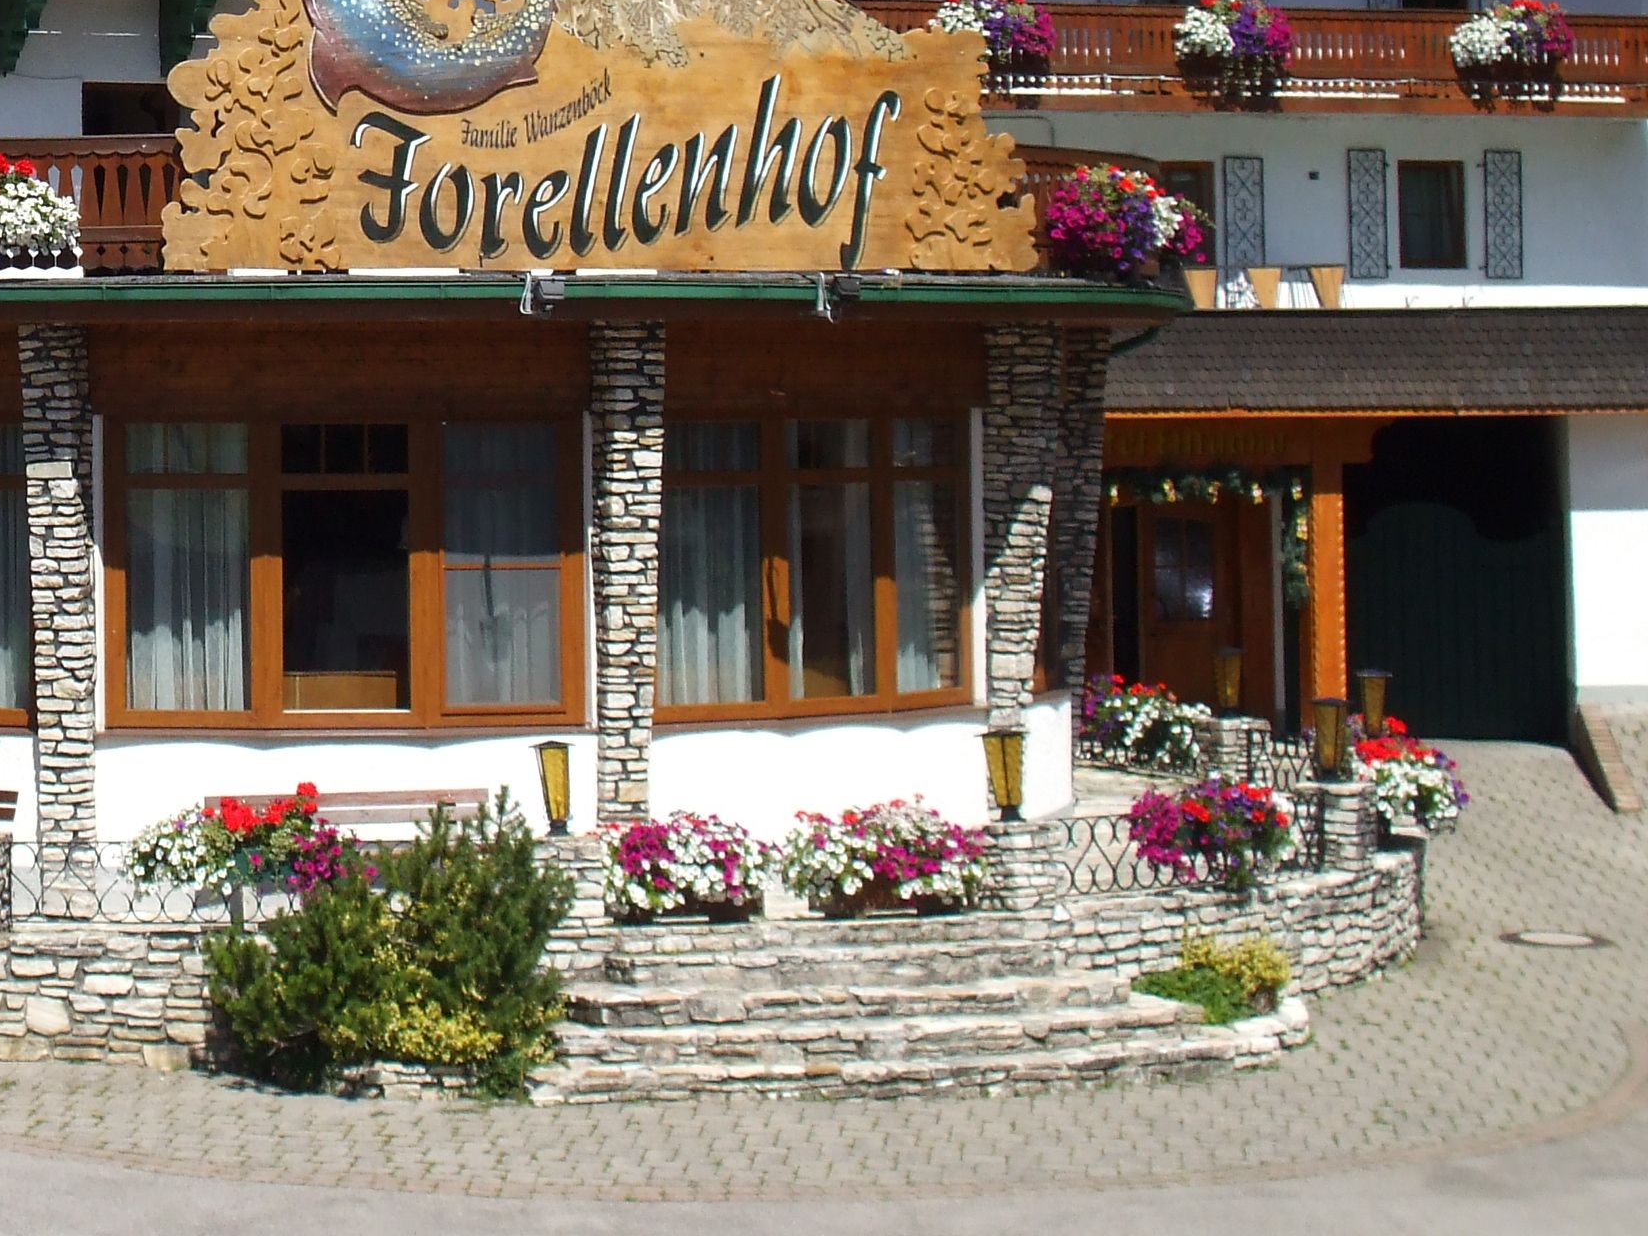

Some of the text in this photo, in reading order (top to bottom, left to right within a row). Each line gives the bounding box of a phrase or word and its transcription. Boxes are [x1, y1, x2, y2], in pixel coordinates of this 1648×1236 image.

[351, 73, 900, 271] Forellenhof
[461, 67, 612, 150] Familie Wanzenböck
